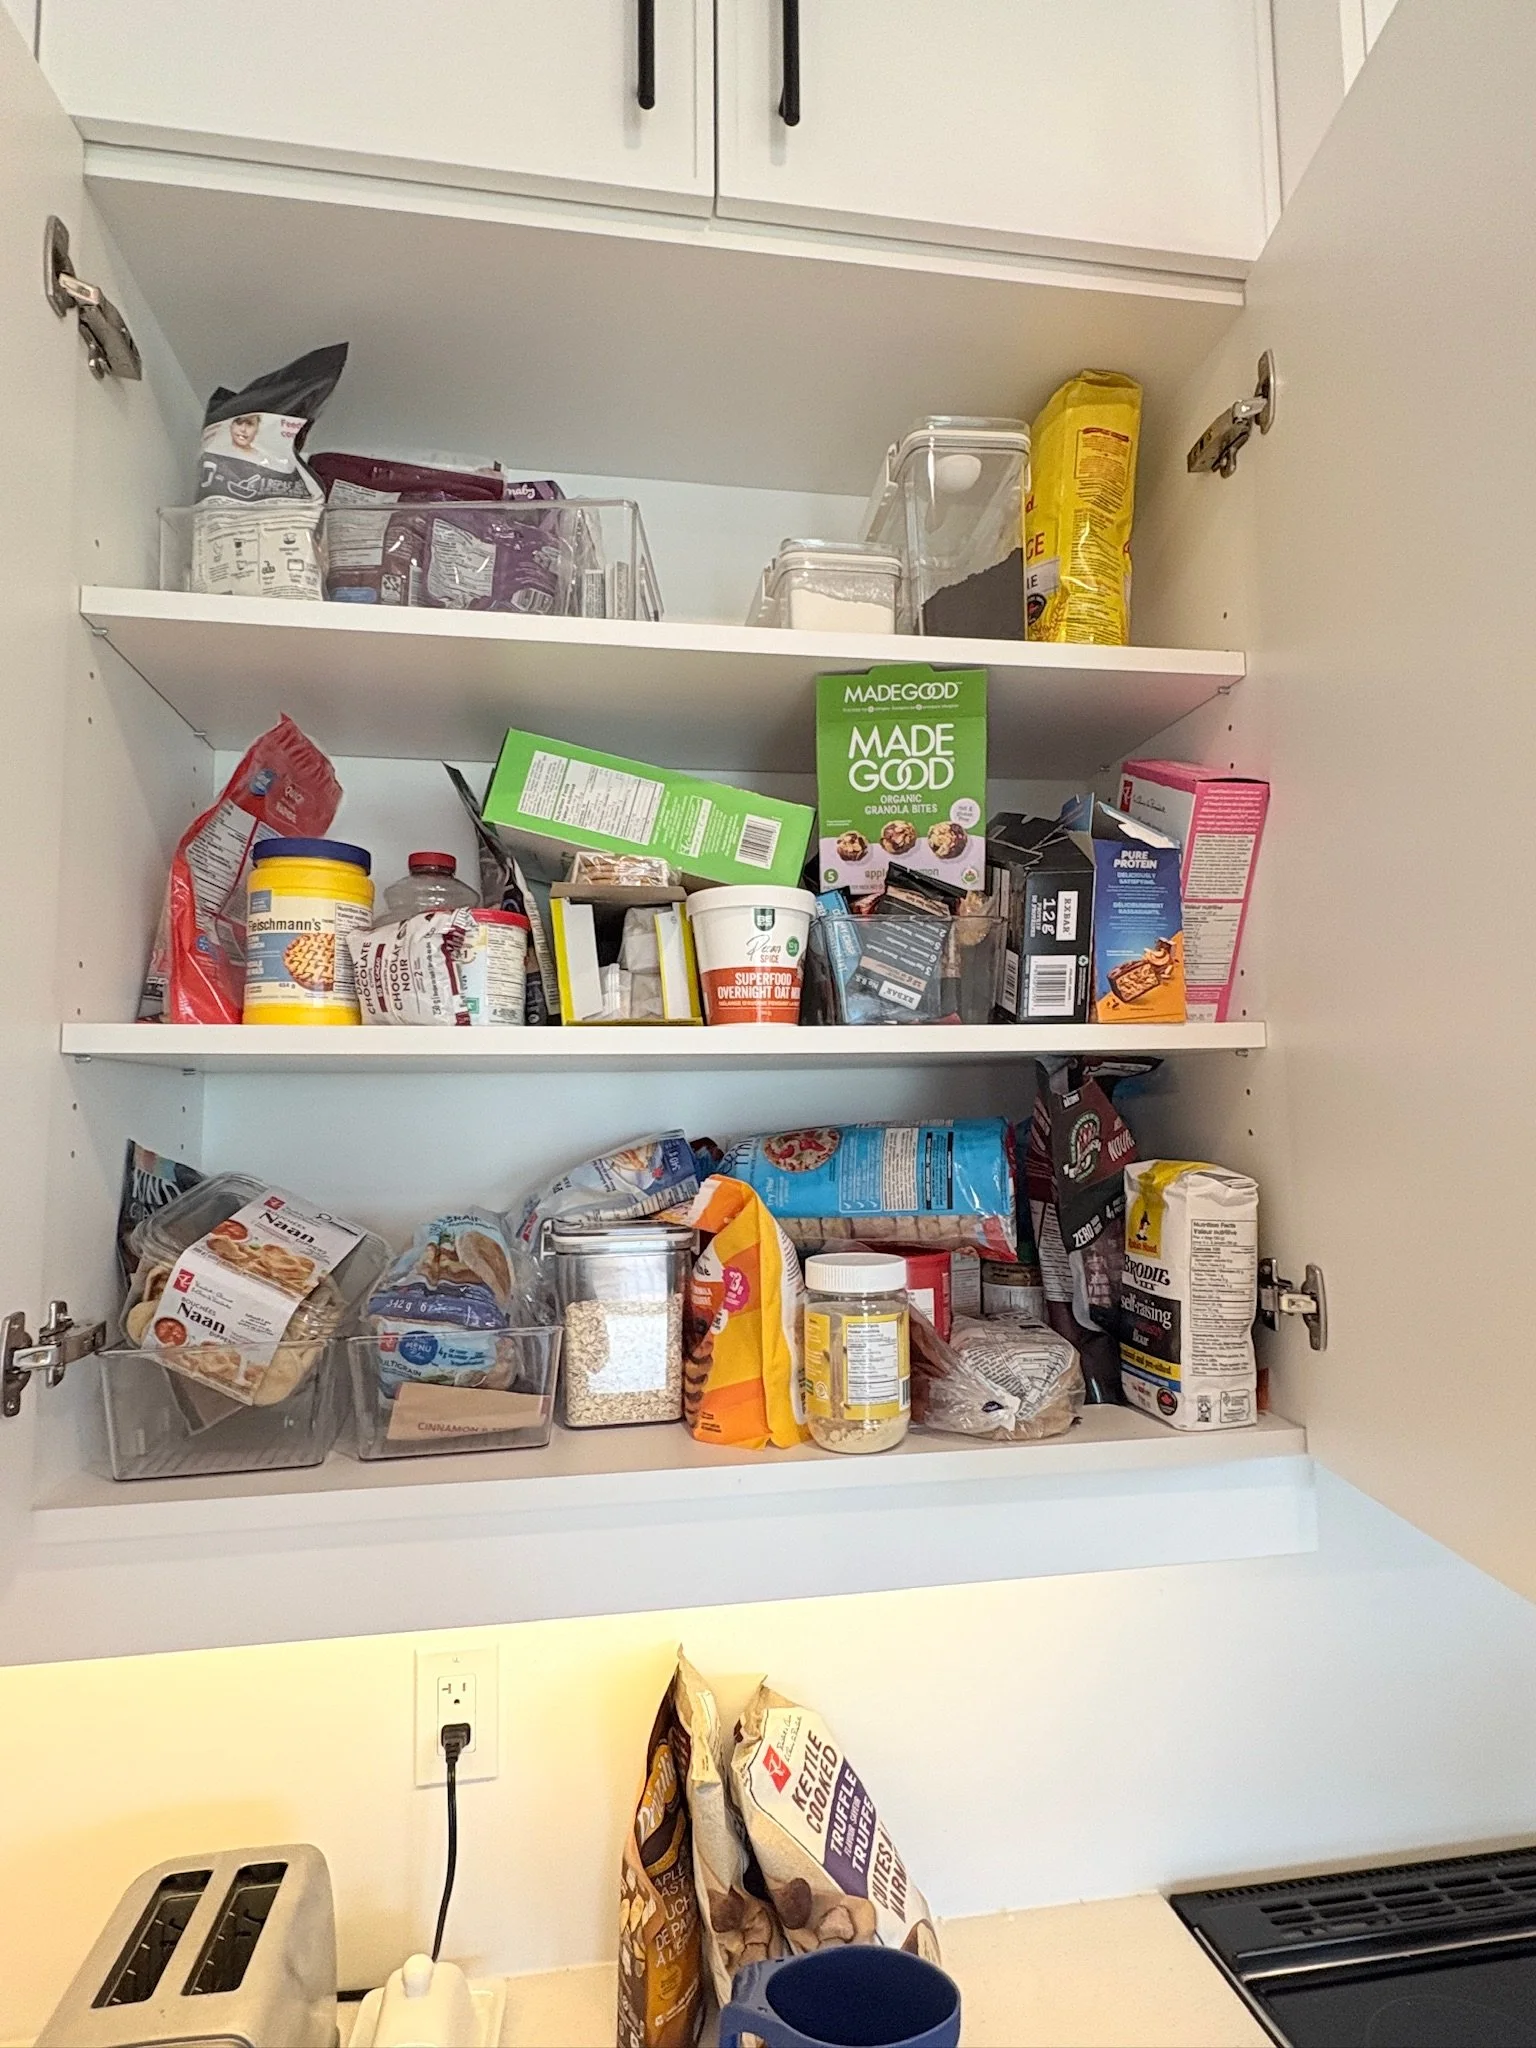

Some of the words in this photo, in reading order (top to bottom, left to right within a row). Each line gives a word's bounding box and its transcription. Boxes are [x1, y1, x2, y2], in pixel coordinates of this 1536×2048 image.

[844, 682, 959, 704] MADEGOOD
[848, 724, 955, 760] MADE
[848, 757, 955, 793] GOOD
[864, 805, 909, 815] GRANOLA
[912, 803, 938, 814] BITES
[880, 794, 922, 804] ORGANIC
[1113, 859, 1157, 869] PROTEIN
[1121, 850, 1149, 860] PURE
[827, 871, 835, 881] 5
[1062, 898, 1071, 934] RXBAR
[938, 928, 948, 938] 2
[933, 941, 943, 951] 5
[928, 954, 938, 963] 6
[360, 942, 376, 1015] CHOCOLATE
[390, 944, 404, 1011] CHOCOLAT
[400, 959, 411, 992] NOIR
[735, 972, 792, 985] SUPERFOOD
[924, 966, 934, 977] 3
[717, 986, 772, 999] OVERNIGHT
[774, 987, 790, 998] OAT
[259, 1212, 315, 1243] Naan
[1072, 1223, 1094, 1248] ZERO
[1123, 1255, 1171, 1287] BRODIE
[177, 1302, 226, 1334] Naan
[405, 1341, 432, 1353] MENU
[1132, 1328, 1150, 1347] flour
[417, 1422, 479, 1433] CINNAMON
[791, 1730, 823, 1813] KETTLE
[806, 1745, 838, 1835] COOKED
[830, 1768, 859, 1857] TRUFFLE
[851, 1796, 876, 1875] TRUFFE
[872, 1842, 893, 1910] CUITES
